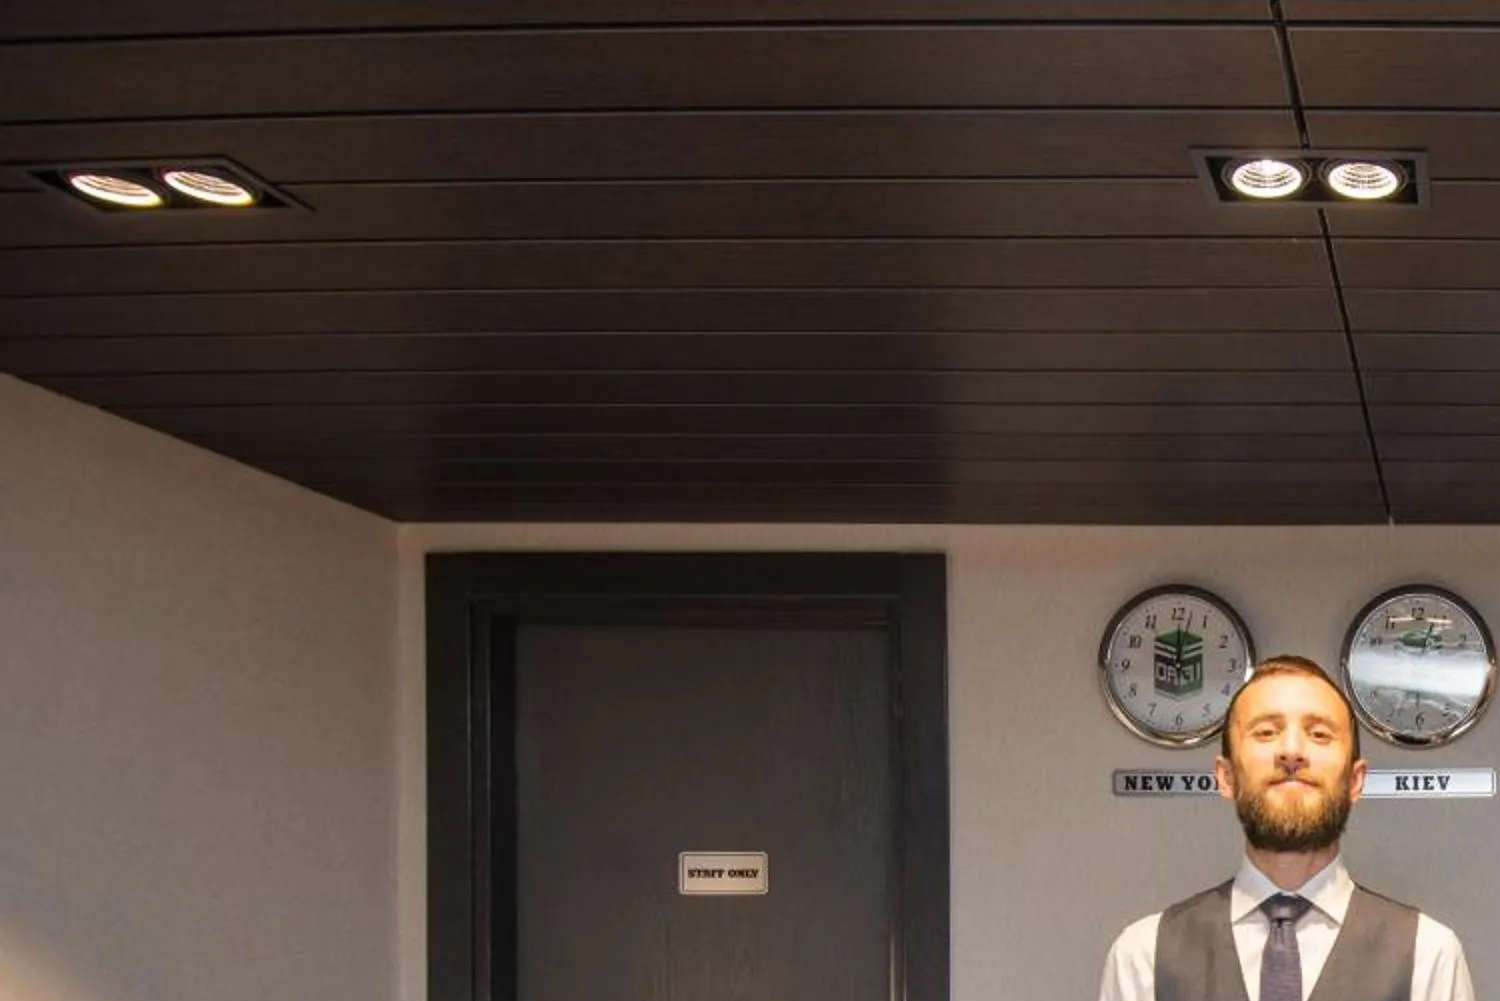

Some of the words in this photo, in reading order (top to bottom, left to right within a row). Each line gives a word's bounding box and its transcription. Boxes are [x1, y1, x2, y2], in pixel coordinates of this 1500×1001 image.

[1171, 607, 1185, 621] 12
[1145, 615, 1157, 629] 11
[1129, 635, 1142, 649] 10
[1219, 635, 1229, 649] 2
[1121, 658, 1131, 672] 9
[1227, 658, 1237, 672] 3
[1128, 683, 1138, 697] 8
[1220, 682, 1231, 696] 4
[1147, 703, 1157, 717] 7
[1175, 714, 1184, 726] 6
[1415, 713, 1425, 727] 6
[1124, 775, 1174, 791] NEW
[1181, 775, 1218, 791] YO
[1395, 775, 1450, 791] KIEV
